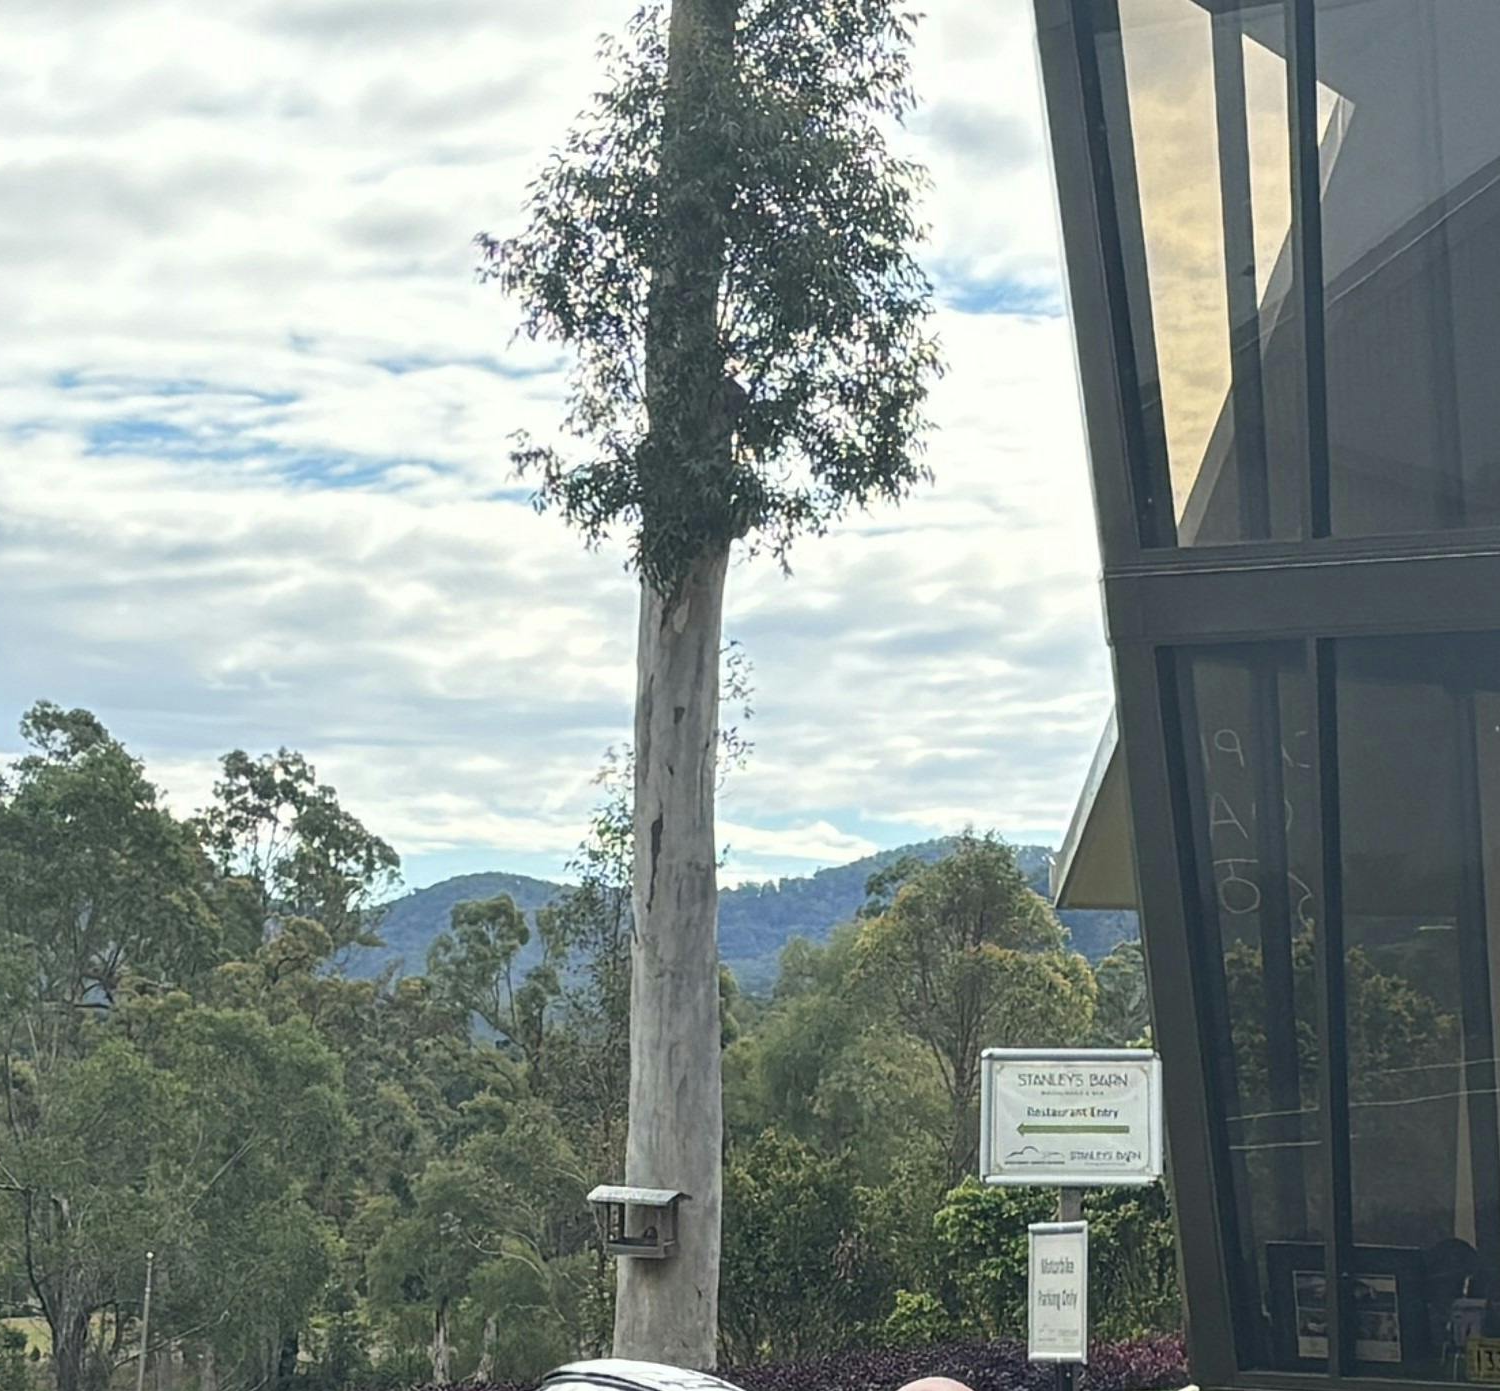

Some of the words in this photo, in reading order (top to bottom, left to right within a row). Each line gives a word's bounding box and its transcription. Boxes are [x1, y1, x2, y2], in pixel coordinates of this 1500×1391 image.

[1089, 1072, 1129, 1088] BARN
[1026, 1106, 1088, 1118] Restaurant
[1091, 1106, 1119, 1119] Entry
